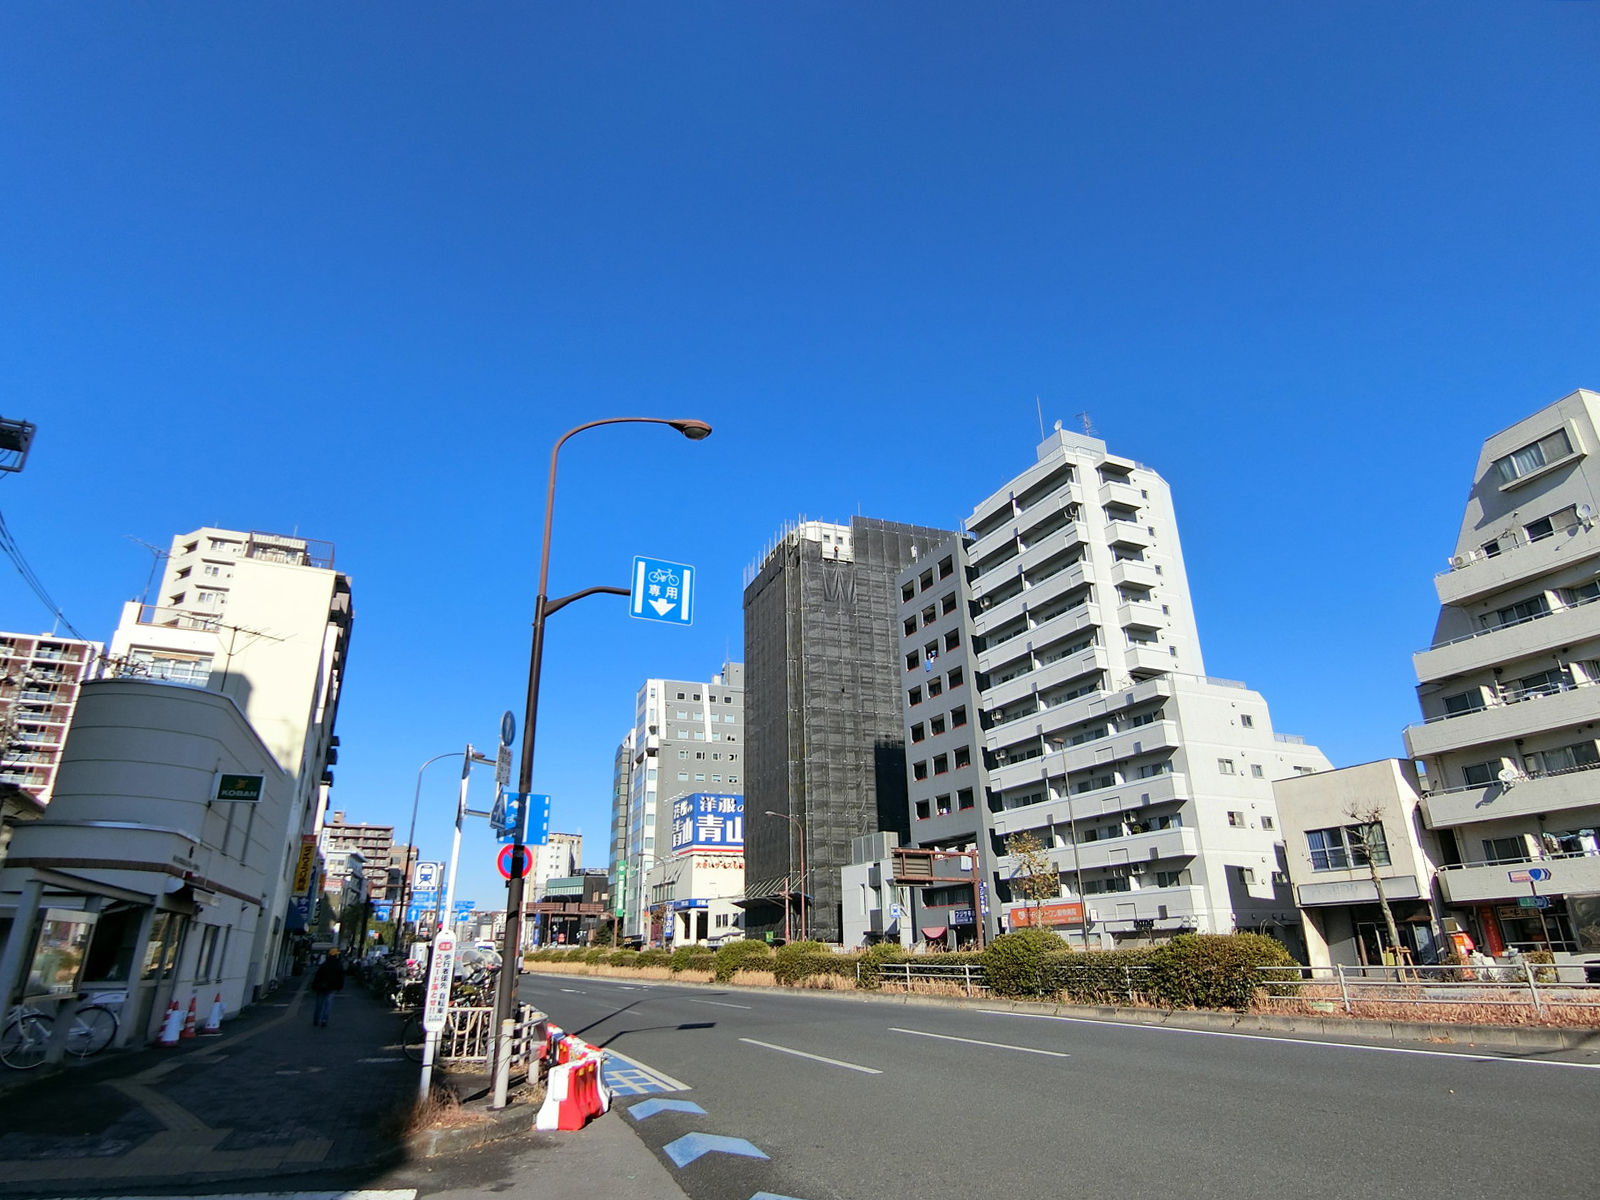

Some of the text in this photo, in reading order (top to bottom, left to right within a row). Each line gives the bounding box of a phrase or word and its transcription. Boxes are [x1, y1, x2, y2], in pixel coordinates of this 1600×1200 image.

[648, 584, 678, 599] 専用
[221, 789, 258, 797] KOBAN
[672, 817, 693, 847] 青山
[696, 814, 744, 842] 青山
[440, 954, 451, 989] 歩行者優先
[436, 992, 446, 1014] 自転車
